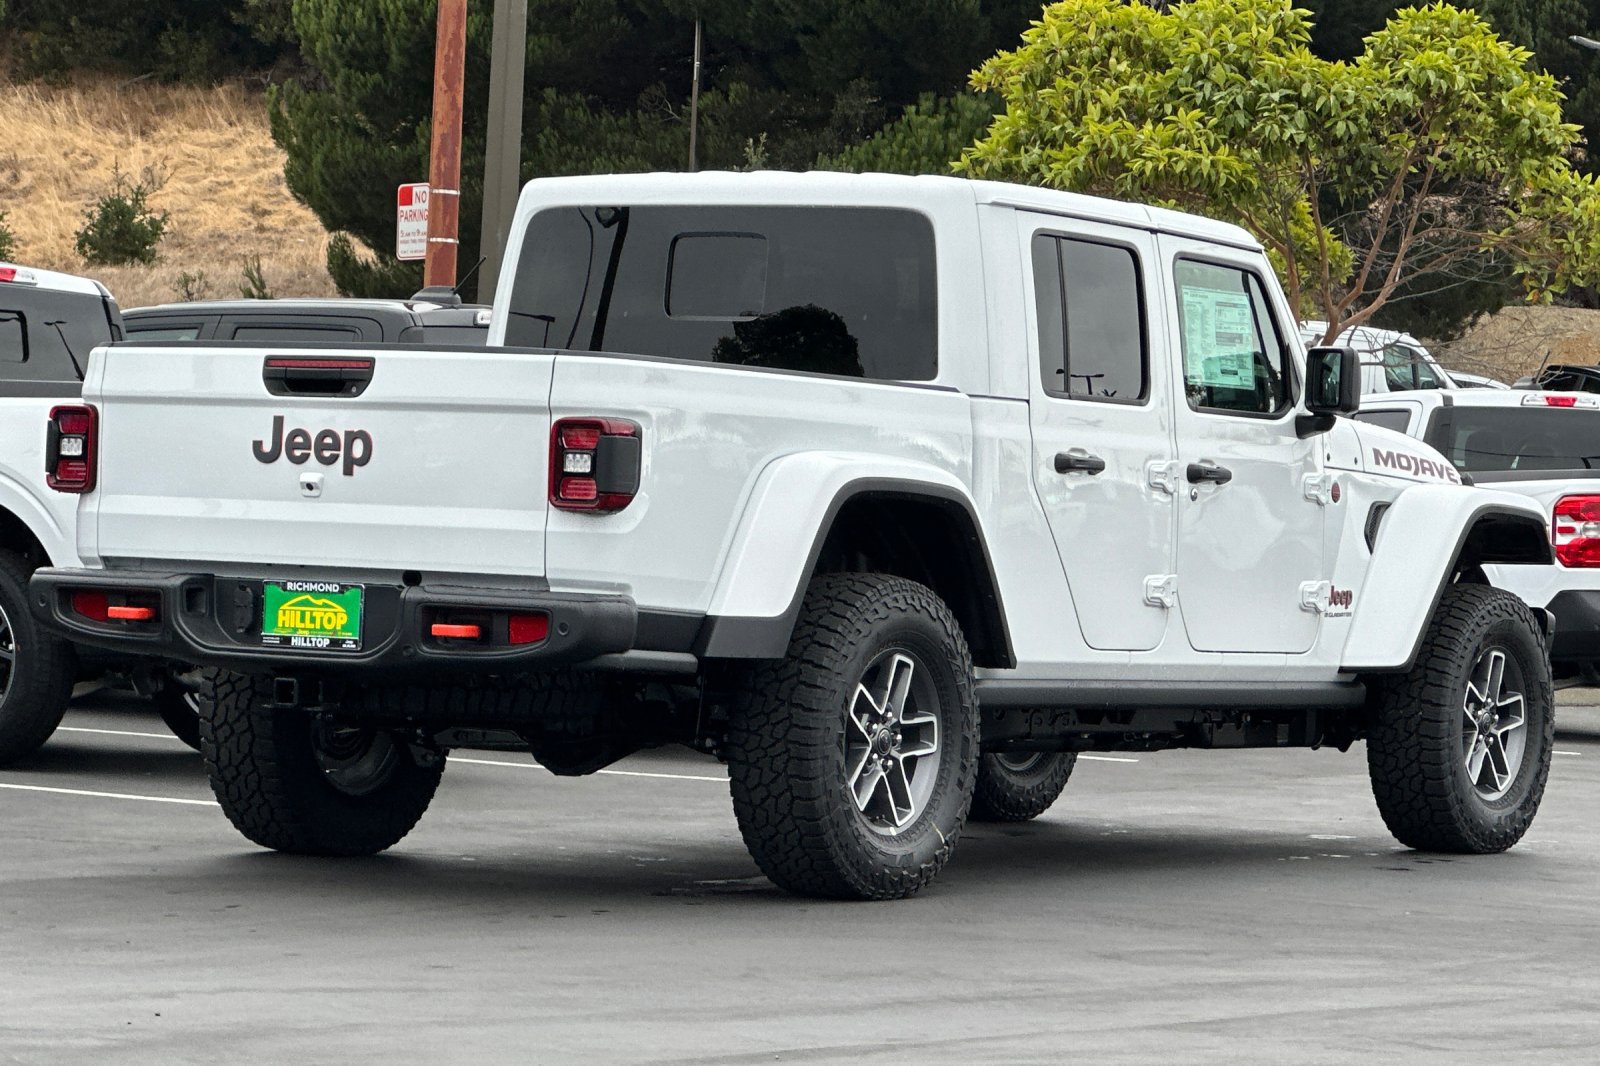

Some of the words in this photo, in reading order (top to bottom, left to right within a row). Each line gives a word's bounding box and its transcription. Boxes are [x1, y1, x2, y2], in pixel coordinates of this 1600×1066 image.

[415, 190, 427, 204] NO
[400, 208, 429, 222] PARKING
[252, 415, 373, 476] Jeep
[1372, 447, 1459, 484] MOJAVE
[286, 581, 340, 592] RICHMOND
[1329, 585, 1353, 610] Jeep
[277, 608, 348, 630] HILLTOP
[290, 636, 330, 648] HILLTOP
